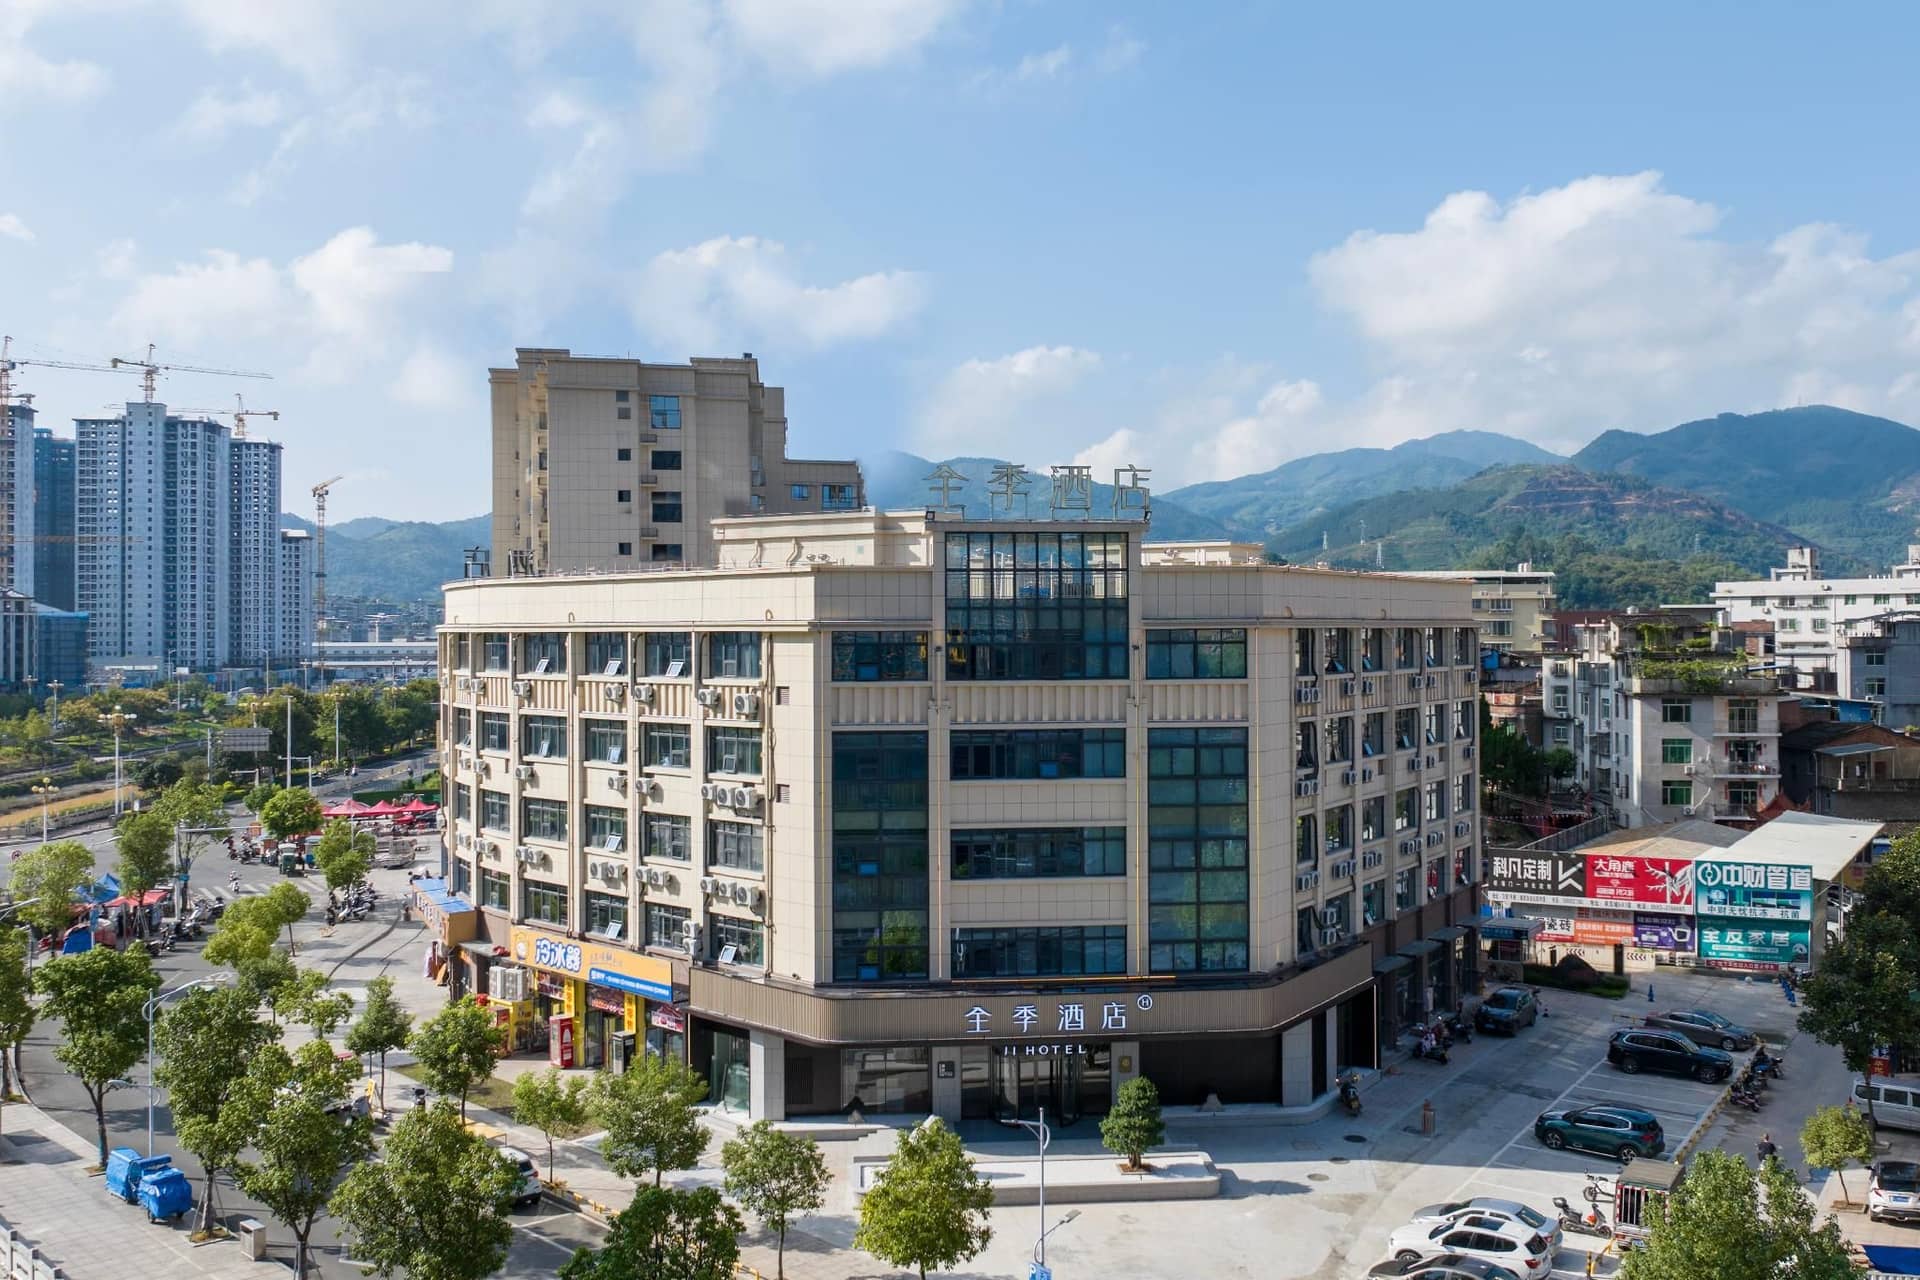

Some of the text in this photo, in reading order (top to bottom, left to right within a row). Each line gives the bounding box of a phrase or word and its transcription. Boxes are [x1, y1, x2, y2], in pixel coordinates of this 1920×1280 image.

[923, 463, 1151, 511] 全季酒店
[1493, 857, 1552, 881] 科凡定制
[1594, 859, 1635, 873] 大角鹿
[1722, 864, 1811, 890] 中财管道
[964, 1002, 1127, 1033] 全季酒店
[1004, 1044, 1088, 1056] JI HOTEL
